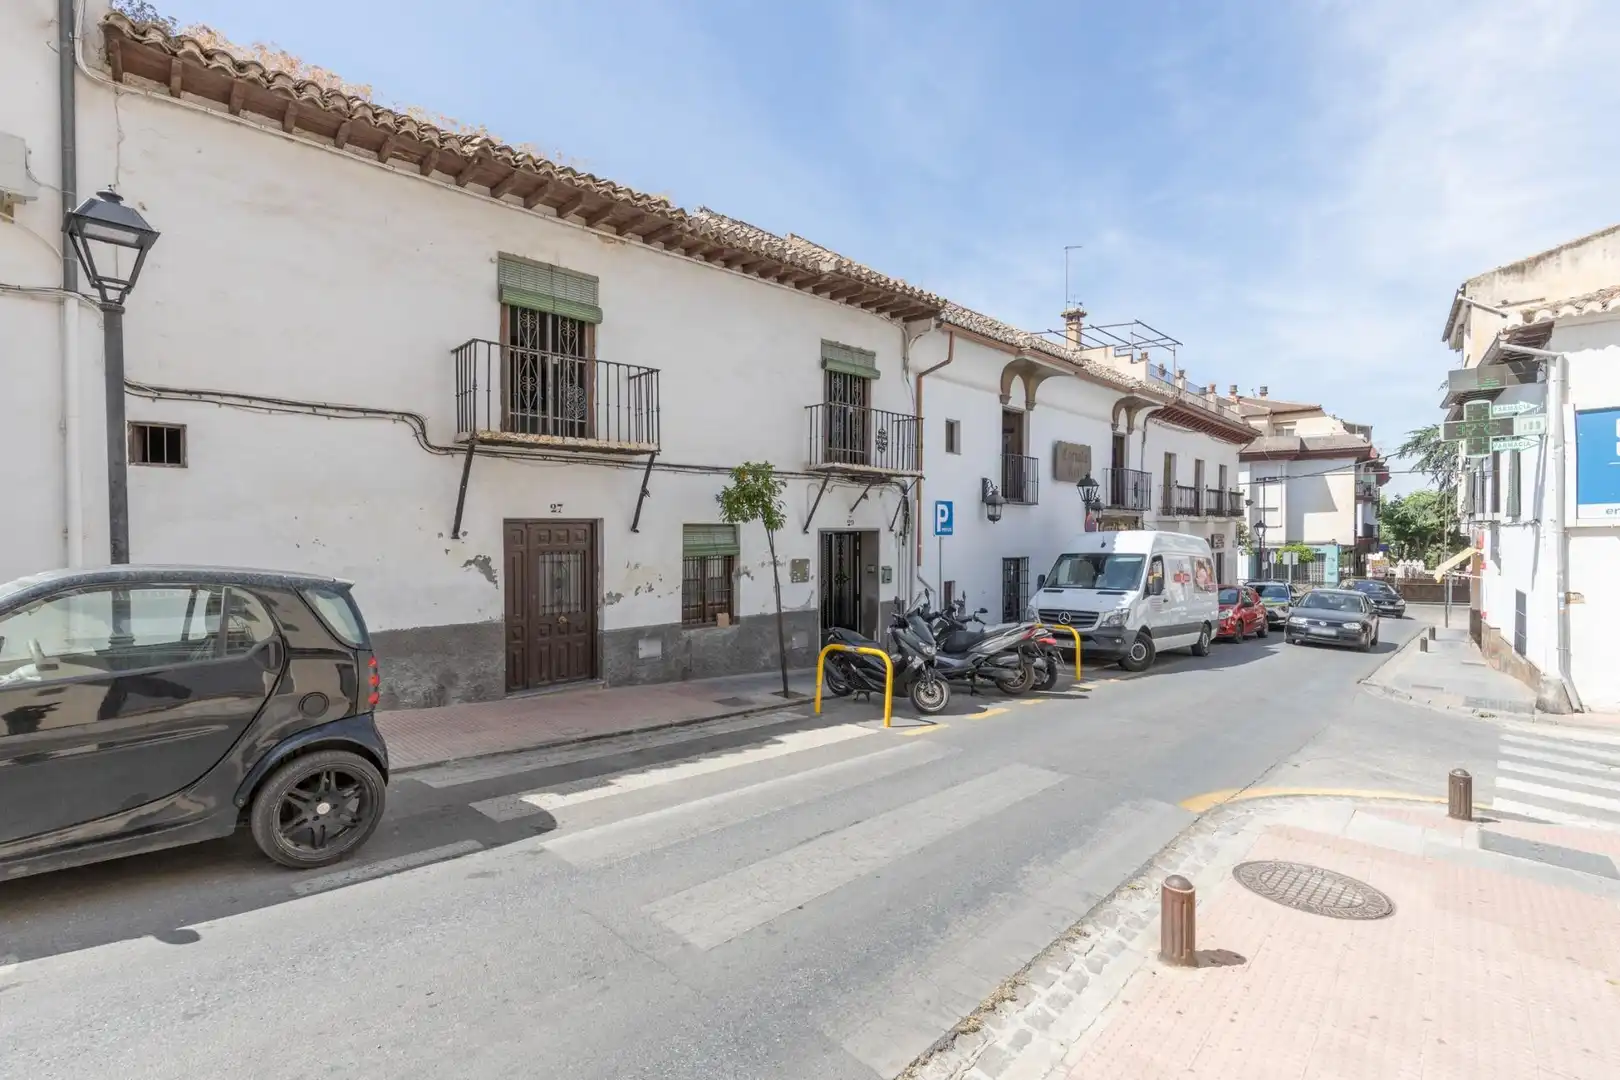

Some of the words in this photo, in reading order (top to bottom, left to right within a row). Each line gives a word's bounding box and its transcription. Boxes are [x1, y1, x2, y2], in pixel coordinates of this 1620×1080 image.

[1493, 402, 1531, 413] FARMACIA
[1493, 440, 1531, 450] FARMACIA
[550, 503, 564, 513] 27
[936, 503, 949, 533] P
